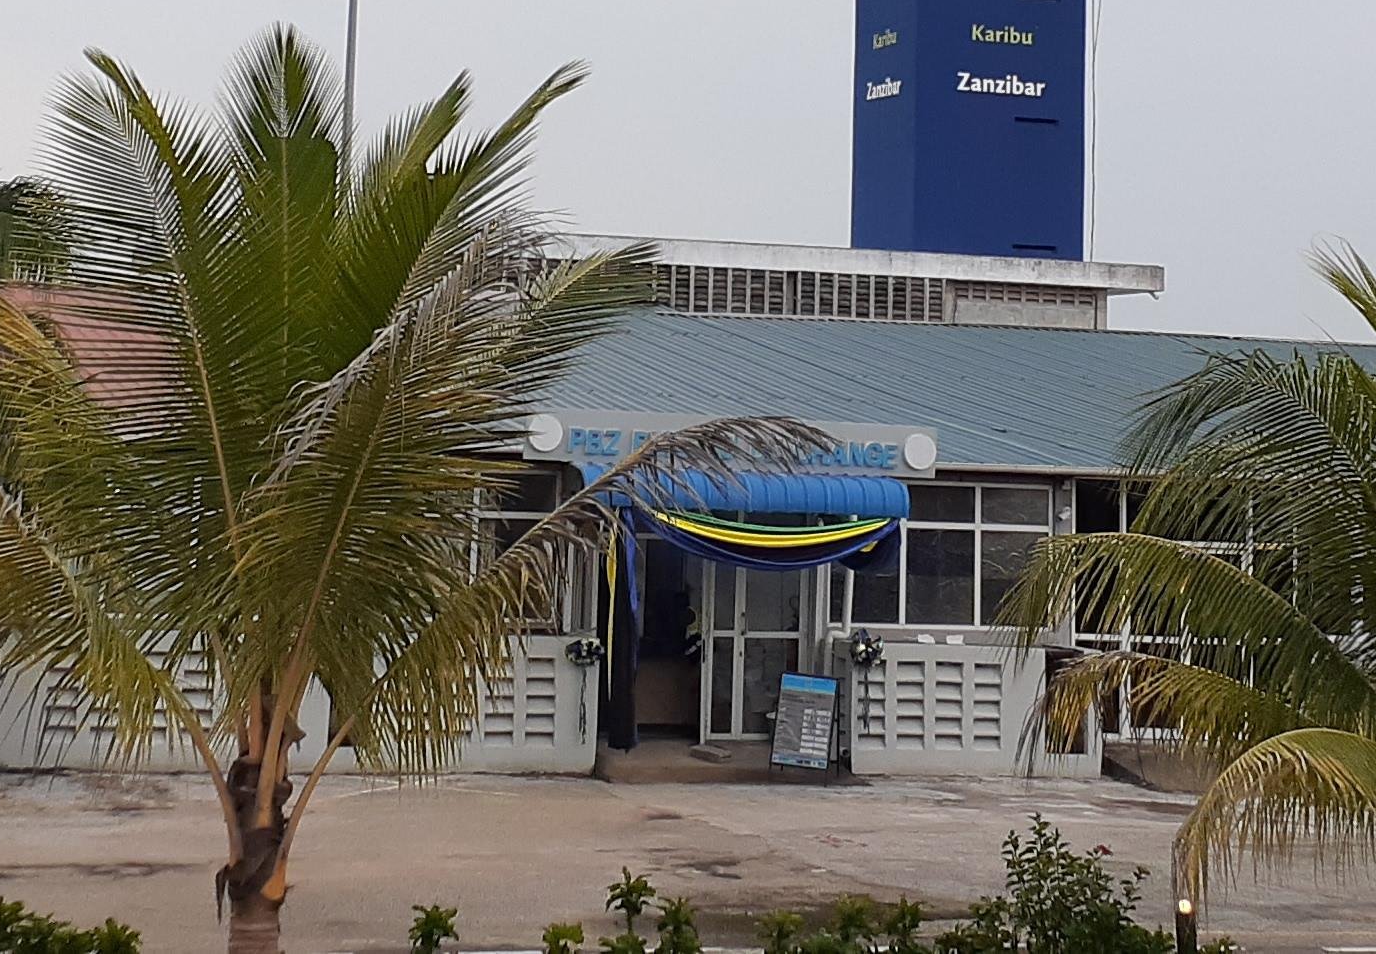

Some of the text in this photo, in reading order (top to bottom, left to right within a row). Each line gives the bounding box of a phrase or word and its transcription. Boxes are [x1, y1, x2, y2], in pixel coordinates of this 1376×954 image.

[873, 29, 897, 49] Karibu
[971, 24, 1033, 45] Karibu
[866, 77, 901, 100] Zanzibar
[957, 72, 1046, 96] Zanzibar
[567, 426, 622, 455] PBZ
